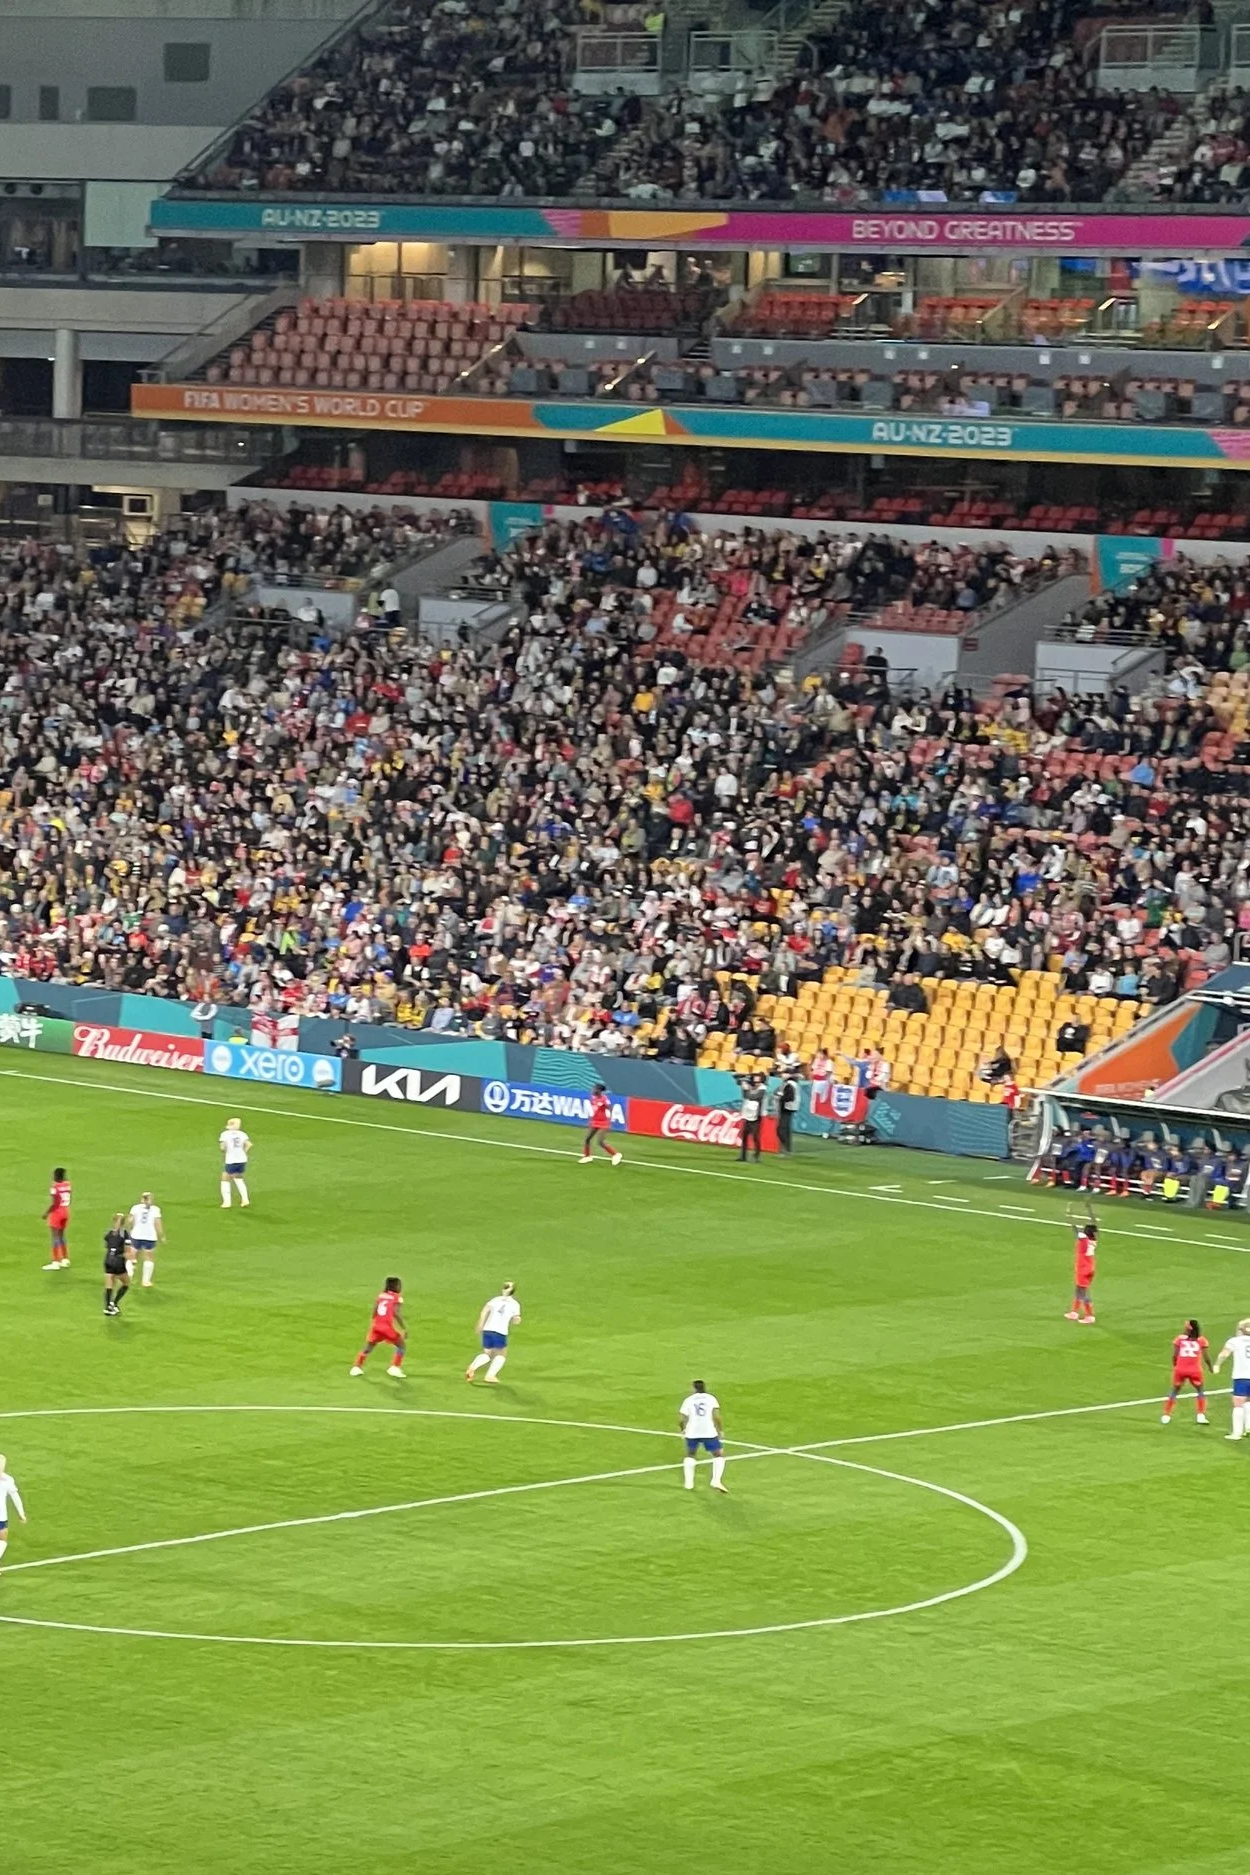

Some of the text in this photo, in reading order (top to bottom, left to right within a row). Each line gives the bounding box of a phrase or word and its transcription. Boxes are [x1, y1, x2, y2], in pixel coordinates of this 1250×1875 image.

[852, 220, 1076, 241] BEYOND GREATNESS
[183, 390, 425, 418] FIFA WOMEN'S WORLD CUP
[0, 1012, 43, 1049] 蒙牛
[73, 1025, 204, 1072] Budweiser
[239, 1047, 316, 1083] xero
[551, 1094, 626, 1125] WANA
